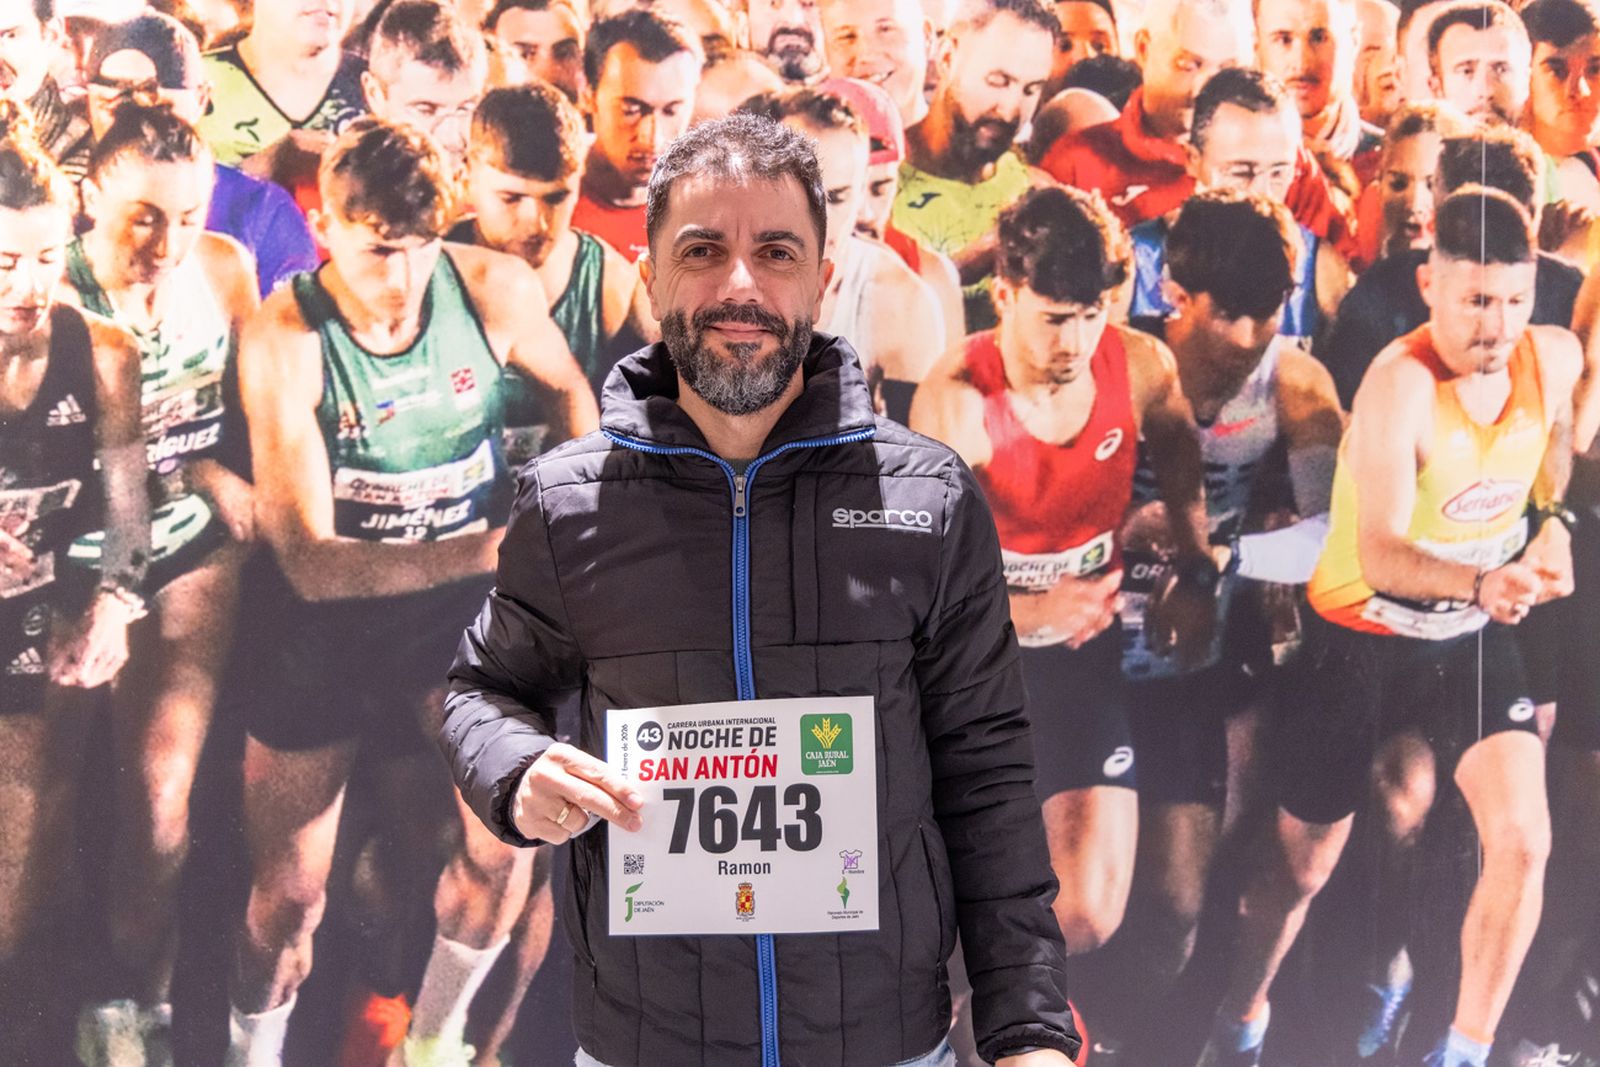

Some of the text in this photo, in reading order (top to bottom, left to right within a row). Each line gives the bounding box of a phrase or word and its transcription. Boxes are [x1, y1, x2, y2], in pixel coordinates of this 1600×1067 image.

[832, 508, 932, 528] sparco
[667, 717, 776, 729] CARRERA URBANA INTERNACIONAL
[637, 728, 662, 744] 43
[668, 726, 777, 750] NOCHE DE
[638, 748, 778, 781] SAN ANTÓN
[663, 783, 823, 854] 7643
[718, 860, 771, 876] Ramon
